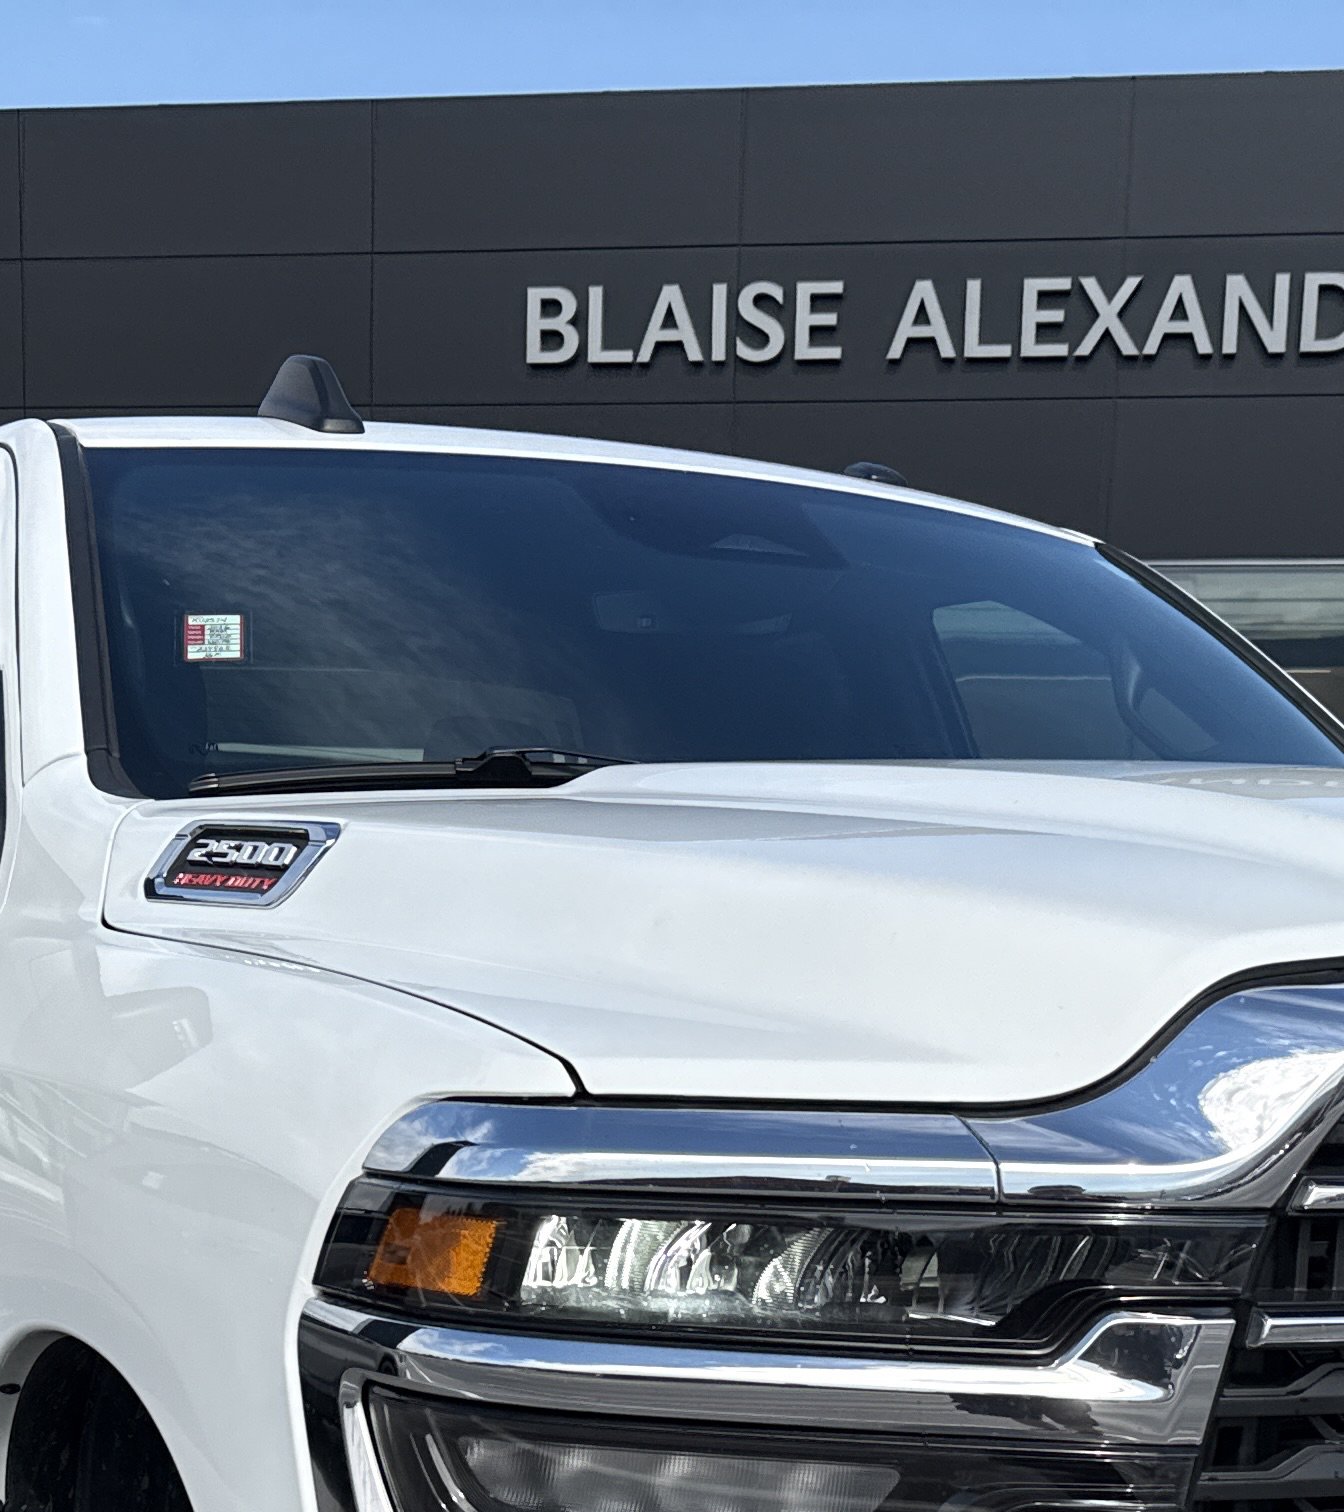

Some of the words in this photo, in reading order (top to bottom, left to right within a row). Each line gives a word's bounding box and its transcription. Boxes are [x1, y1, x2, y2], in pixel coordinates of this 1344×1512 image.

[525, 280, 843, 366] BLAISE
[186, 839, 298, 867] 2500
[173, 873, 224, 887] HEAVY
[227, 876, 278, 890] DUTY
